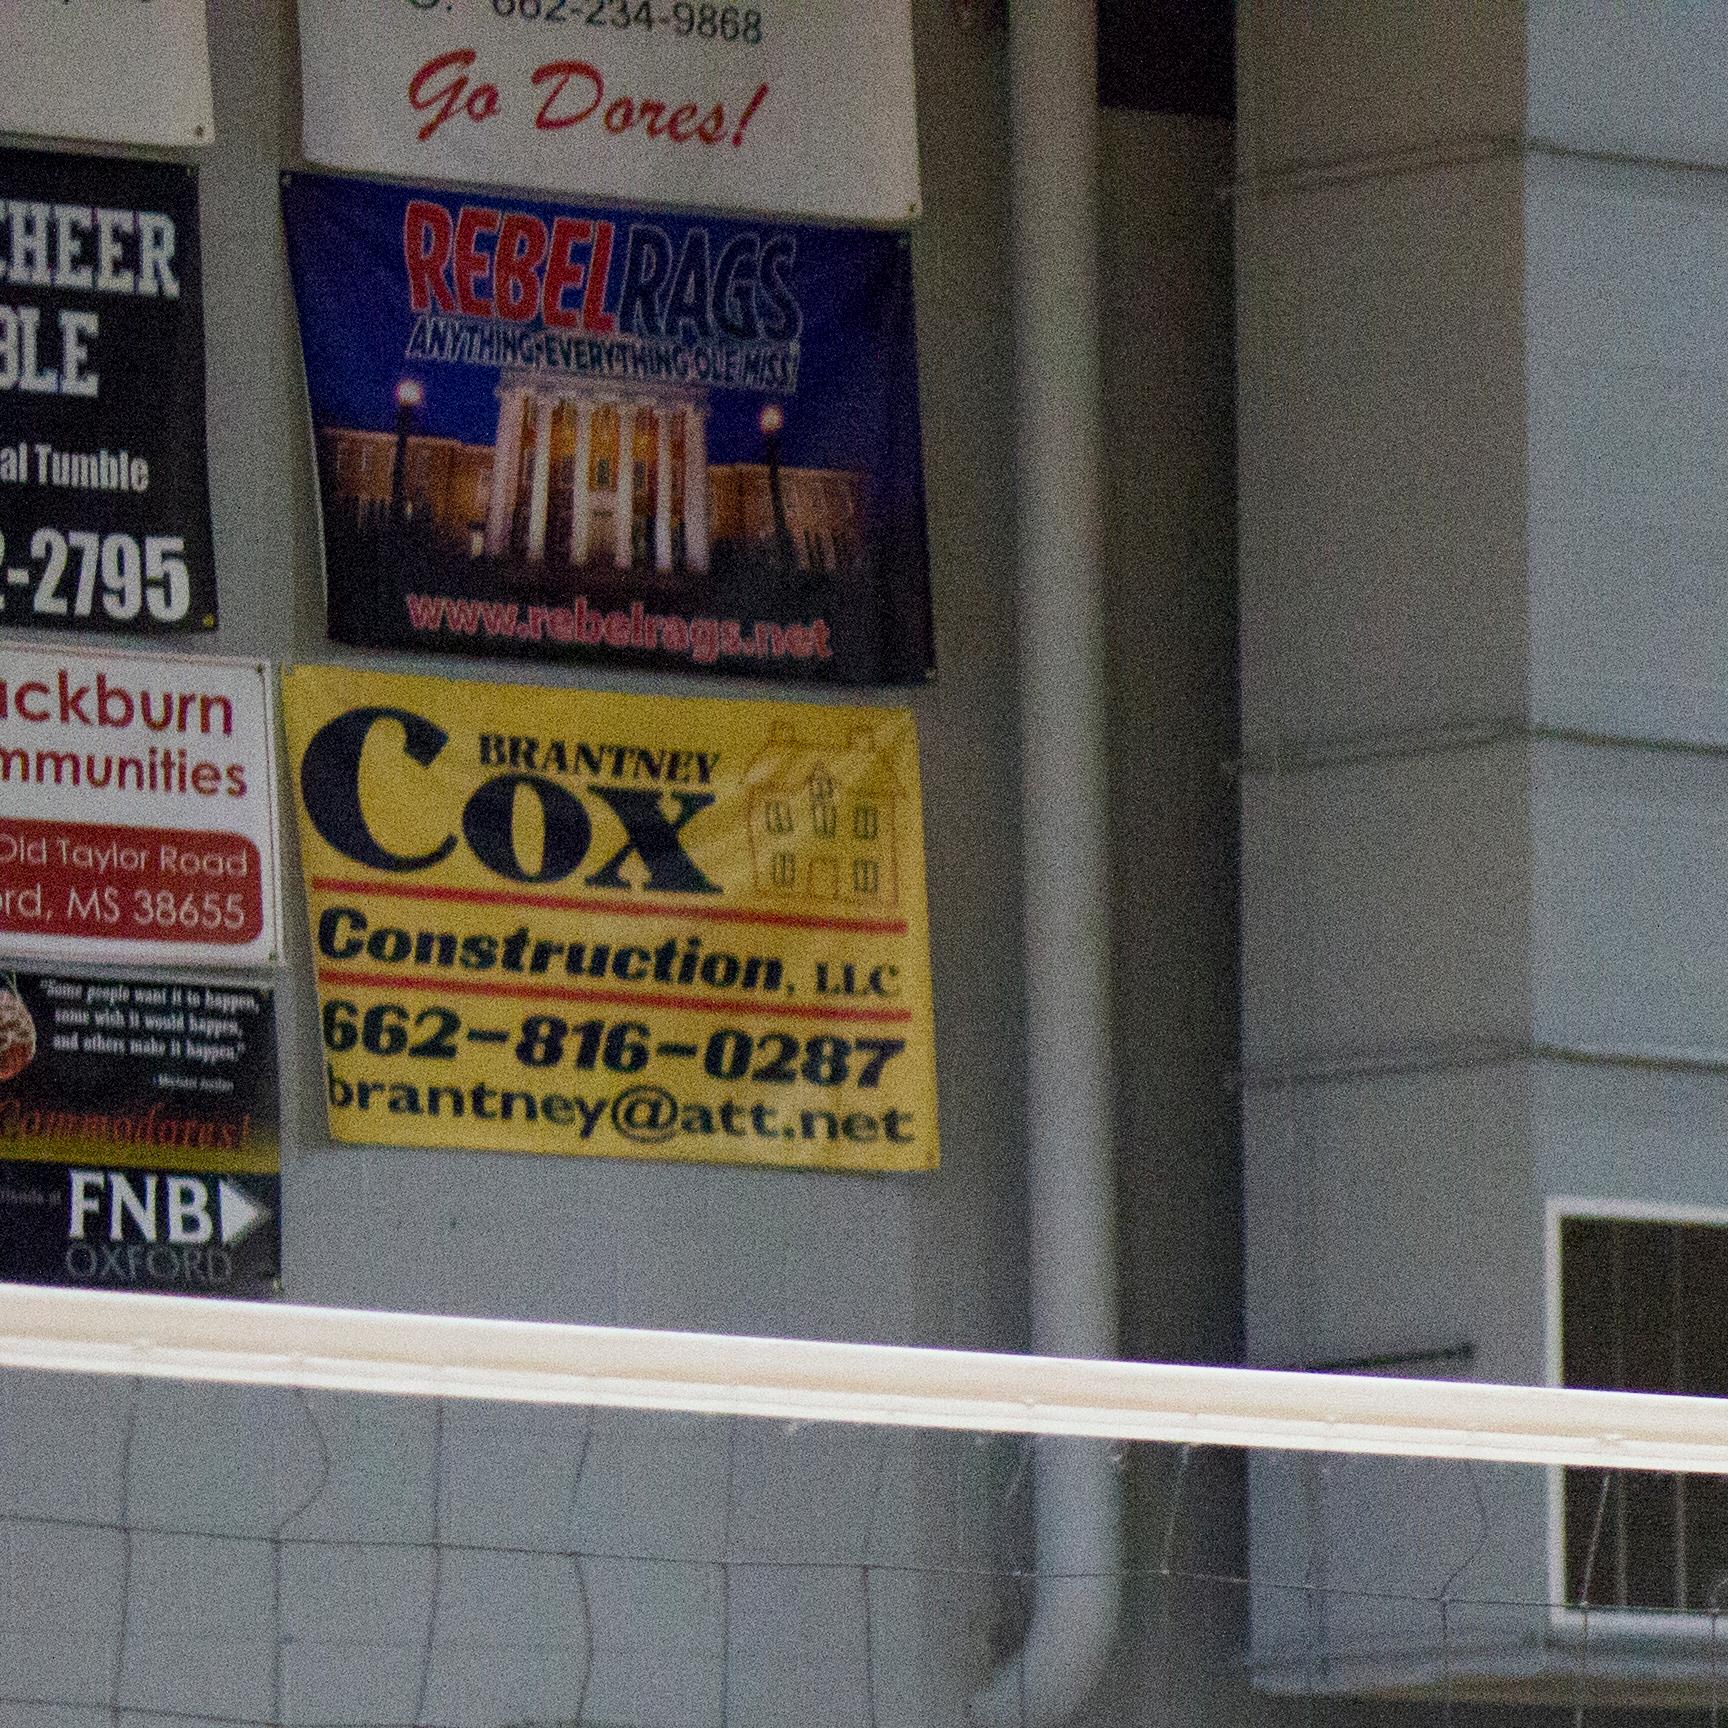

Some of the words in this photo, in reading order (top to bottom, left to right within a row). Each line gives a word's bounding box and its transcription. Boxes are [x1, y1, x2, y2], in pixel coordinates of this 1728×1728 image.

[408, 48, 500, 142] Go
[530, 61, 770, 148] Dores!
[0, 200, 181, 299] HEER
[404, 200, 616, 334] REBEL
[36, 444, 150, 493] Tumble
[0, 527, 191, 622] -2795
[407, 593, 834, 664] www.rebelrags.net
[0, 667, 235, 738] ckburn
[479, 733, 720, 786] BRANTNEY
[57, 837, 150, 875] Taylor
[159, 845, 249, 879] Road
[0, 882, 53, 922] rd,
[66, 886, 121, 924] MS
[133, 889, 246, 931] 38655
[318, 905, 798, 996] Construction,
[815, 960, 902, 1000] LLC
[323, 1000, 906, 1088] 662-816-0287
[328, 1063, 915, 1145] brantney@att.net
[67, 1169, 214, 1244] FNB
[64, 1243, 234, 1283] OXFORD
